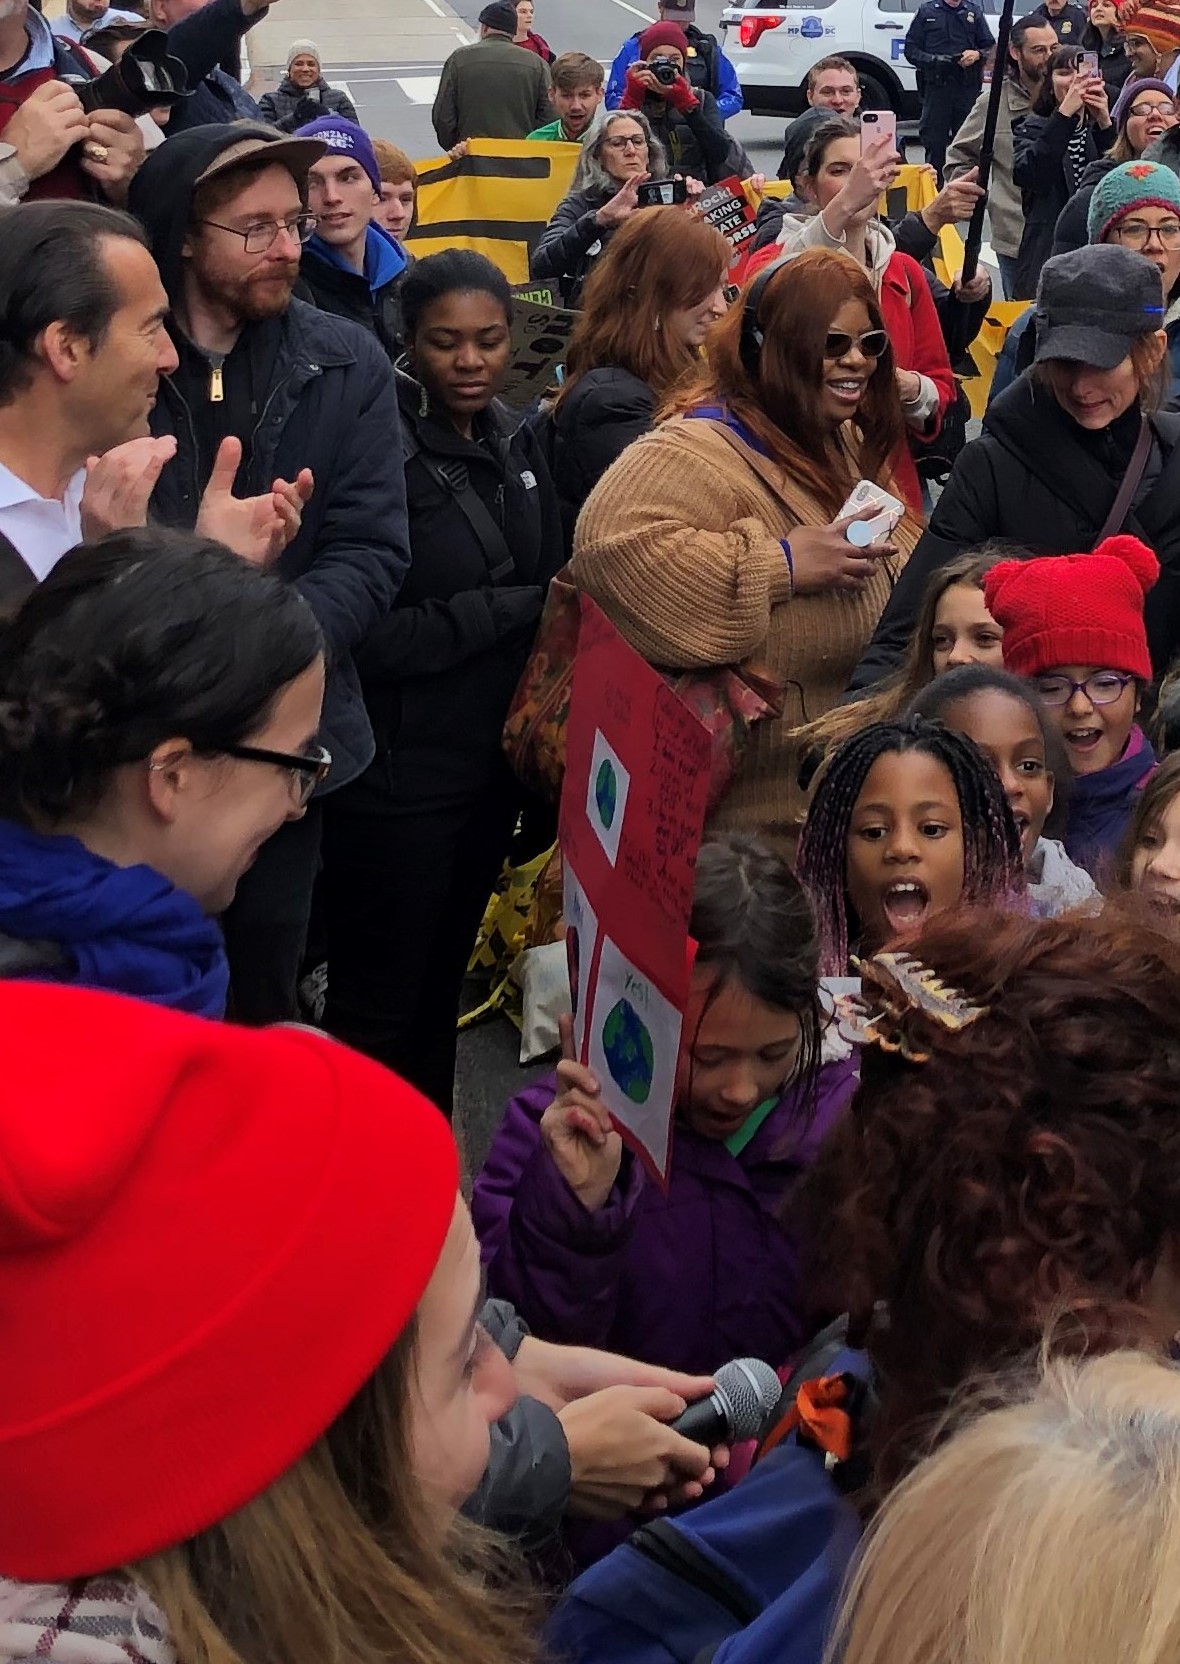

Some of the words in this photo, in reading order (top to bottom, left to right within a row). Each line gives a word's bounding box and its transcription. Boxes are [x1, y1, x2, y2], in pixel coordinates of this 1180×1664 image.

[703, 199, 742, 224] AKING
[719, 214, 742, 233] ATE
[725, 222, 757, 246] ORSE
